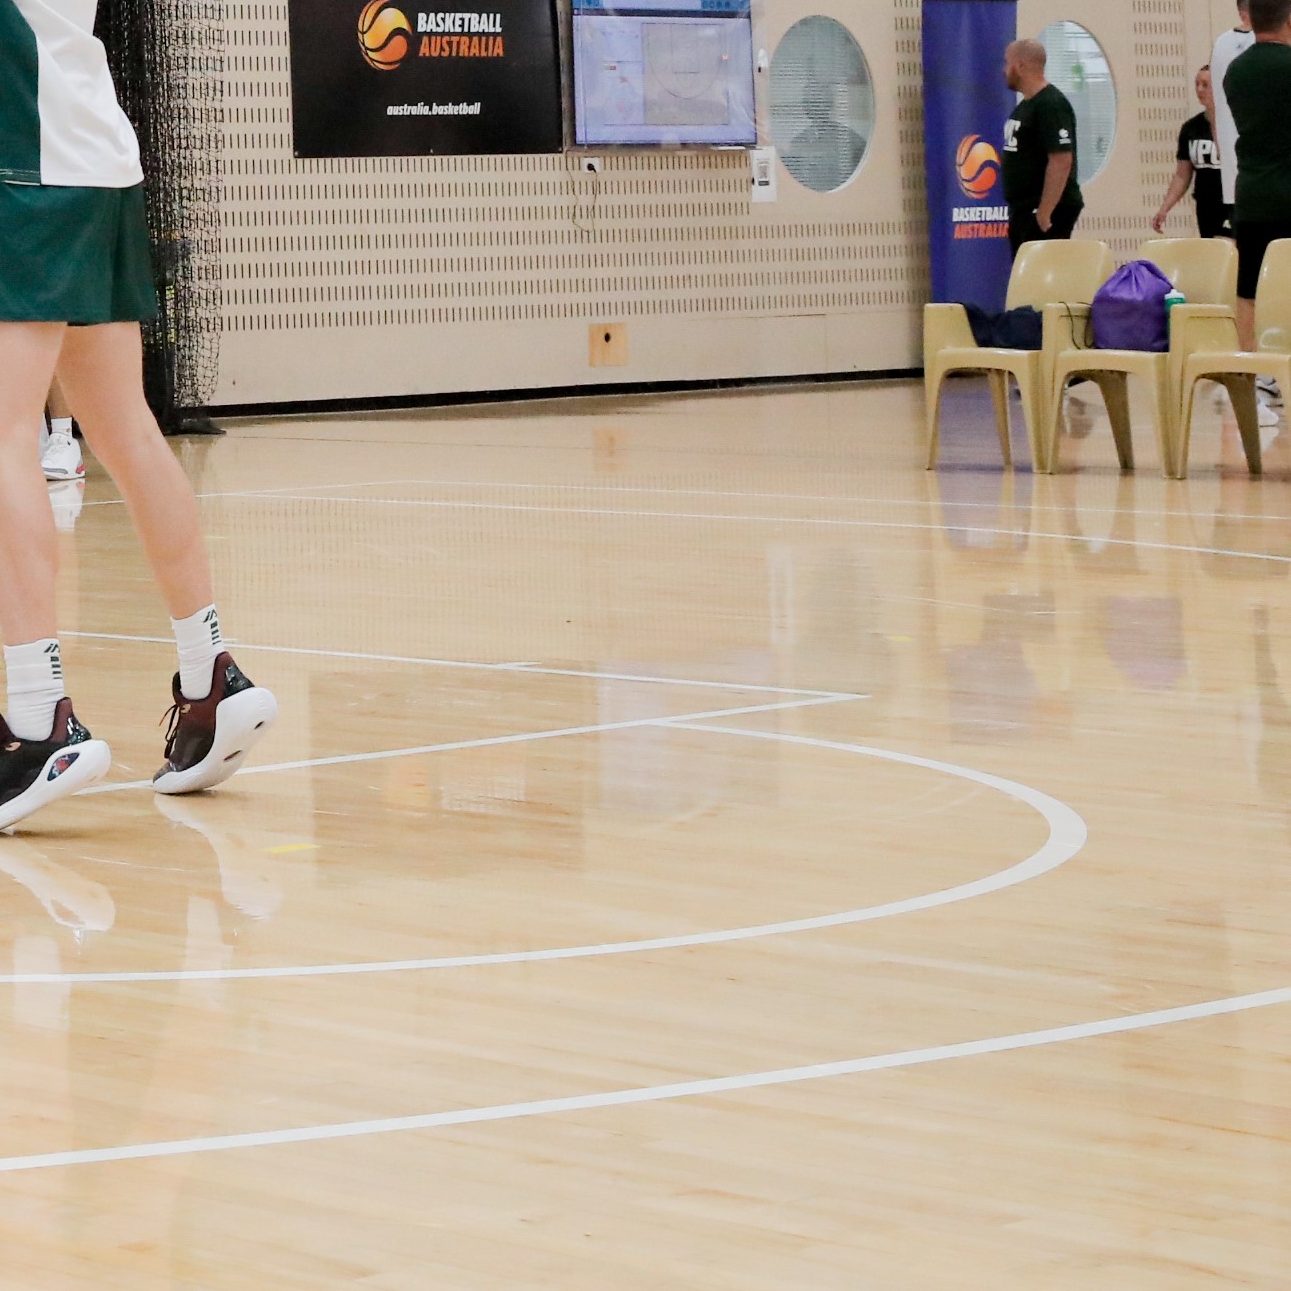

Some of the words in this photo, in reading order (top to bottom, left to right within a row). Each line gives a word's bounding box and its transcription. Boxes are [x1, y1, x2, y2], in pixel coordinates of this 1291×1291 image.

[417, 12, 503, 33] BASKETBALL
[418, 36, 504, 57] AUSTRALIA
[386, 101, 481, 116] australia.basketball
[952, 206, 1009, 222] BASKETBALL
